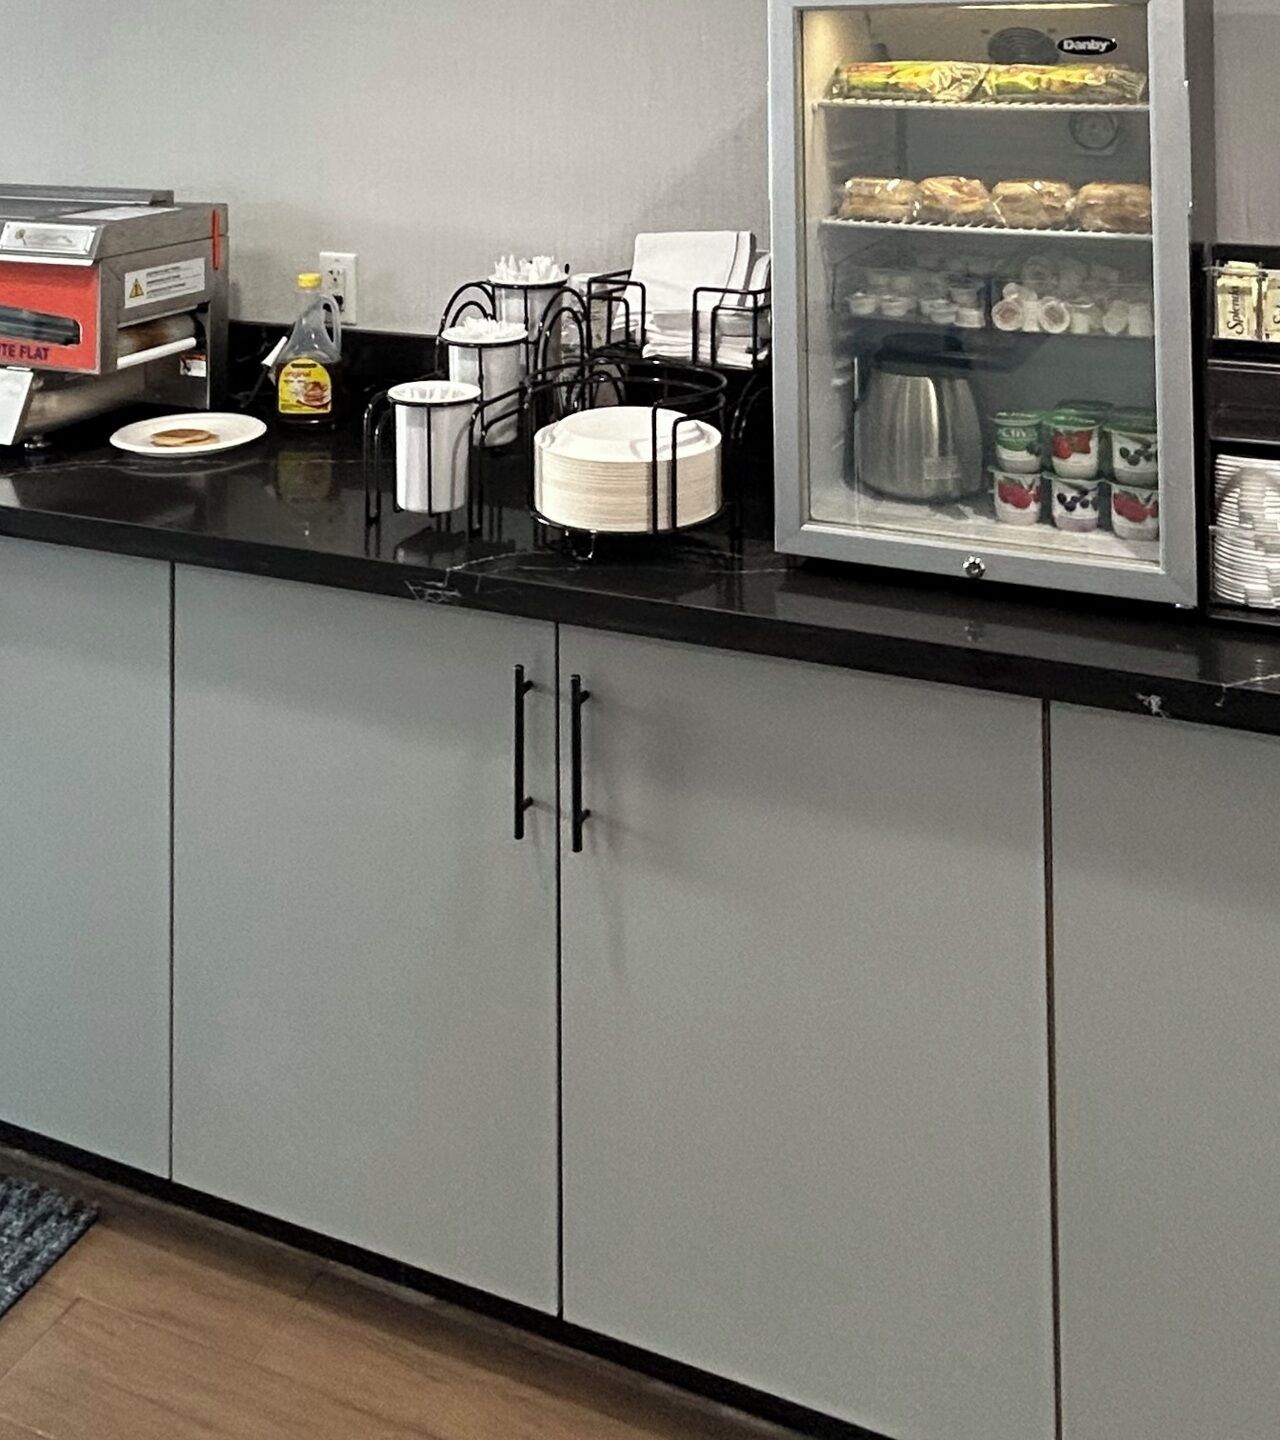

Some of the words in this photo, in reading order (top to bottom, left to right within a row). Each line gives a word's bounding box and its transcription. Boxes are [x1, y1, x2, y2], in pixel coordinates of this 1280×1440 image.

[1062, 39, 1110, 52] Danby
[1226, 286, 1245, 335] Splenda
[19, 344, 50, 361] FLAT
